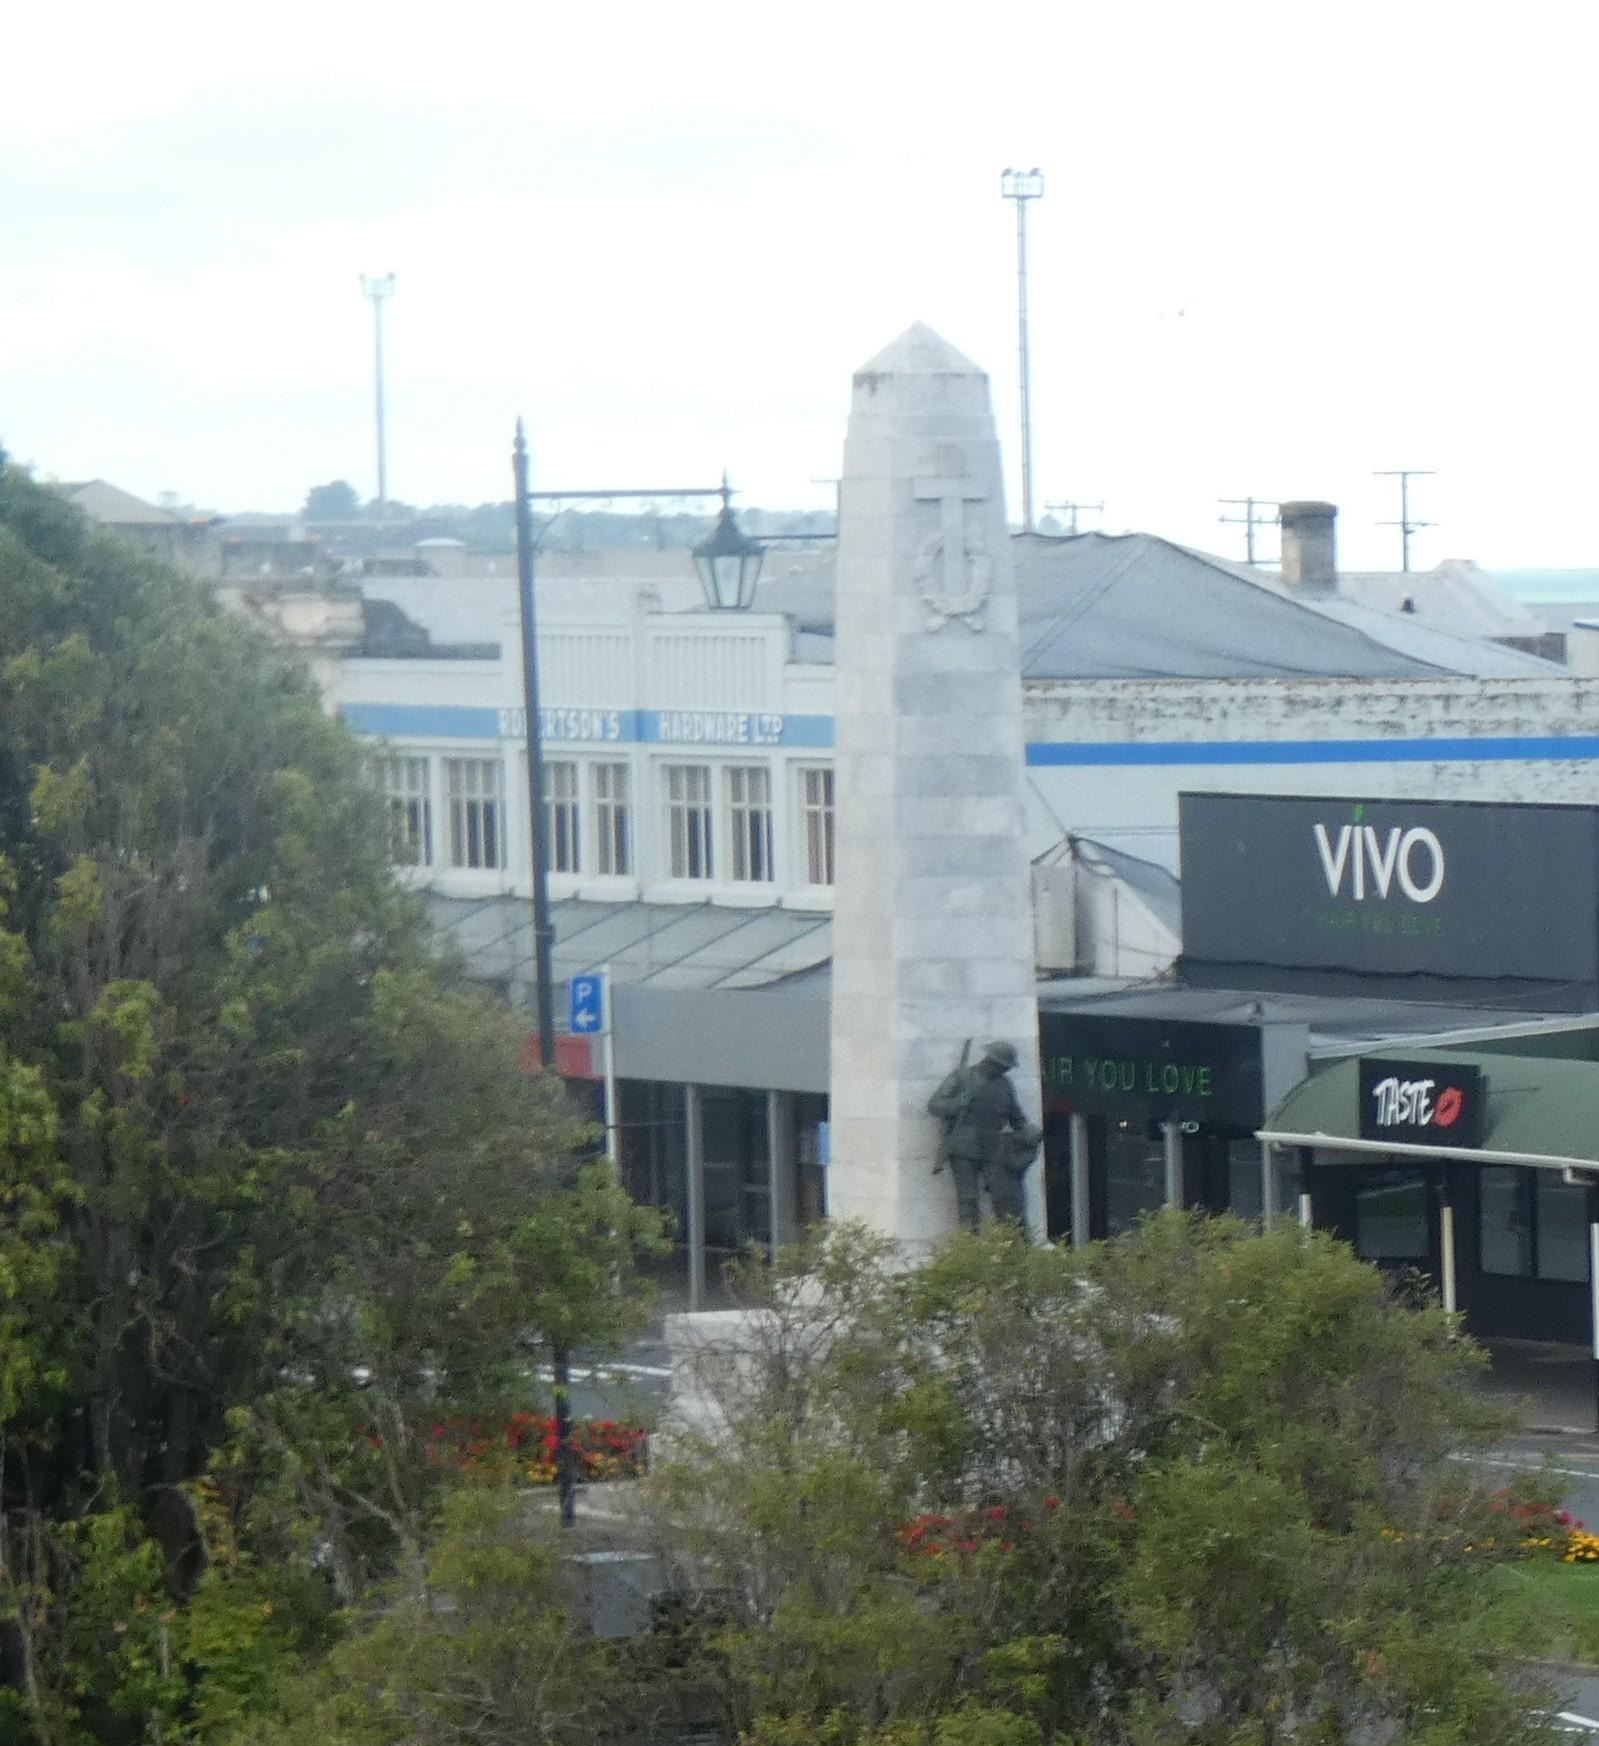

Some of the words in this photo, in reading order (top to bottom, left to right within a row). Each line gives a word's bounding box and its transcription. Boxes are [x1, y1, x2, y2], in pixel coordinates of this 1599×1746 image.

[659, 710, 748, 744] HARDWARE
[1312, 822, 1445, 904] VIVO
[575, 982, 593, 1004] P
[1087, 1059, 1136, 1091] YOU
[1146, 1061, 1213, 1096] LOVE
[1372, 1077, 1436, 1127] TASTE
